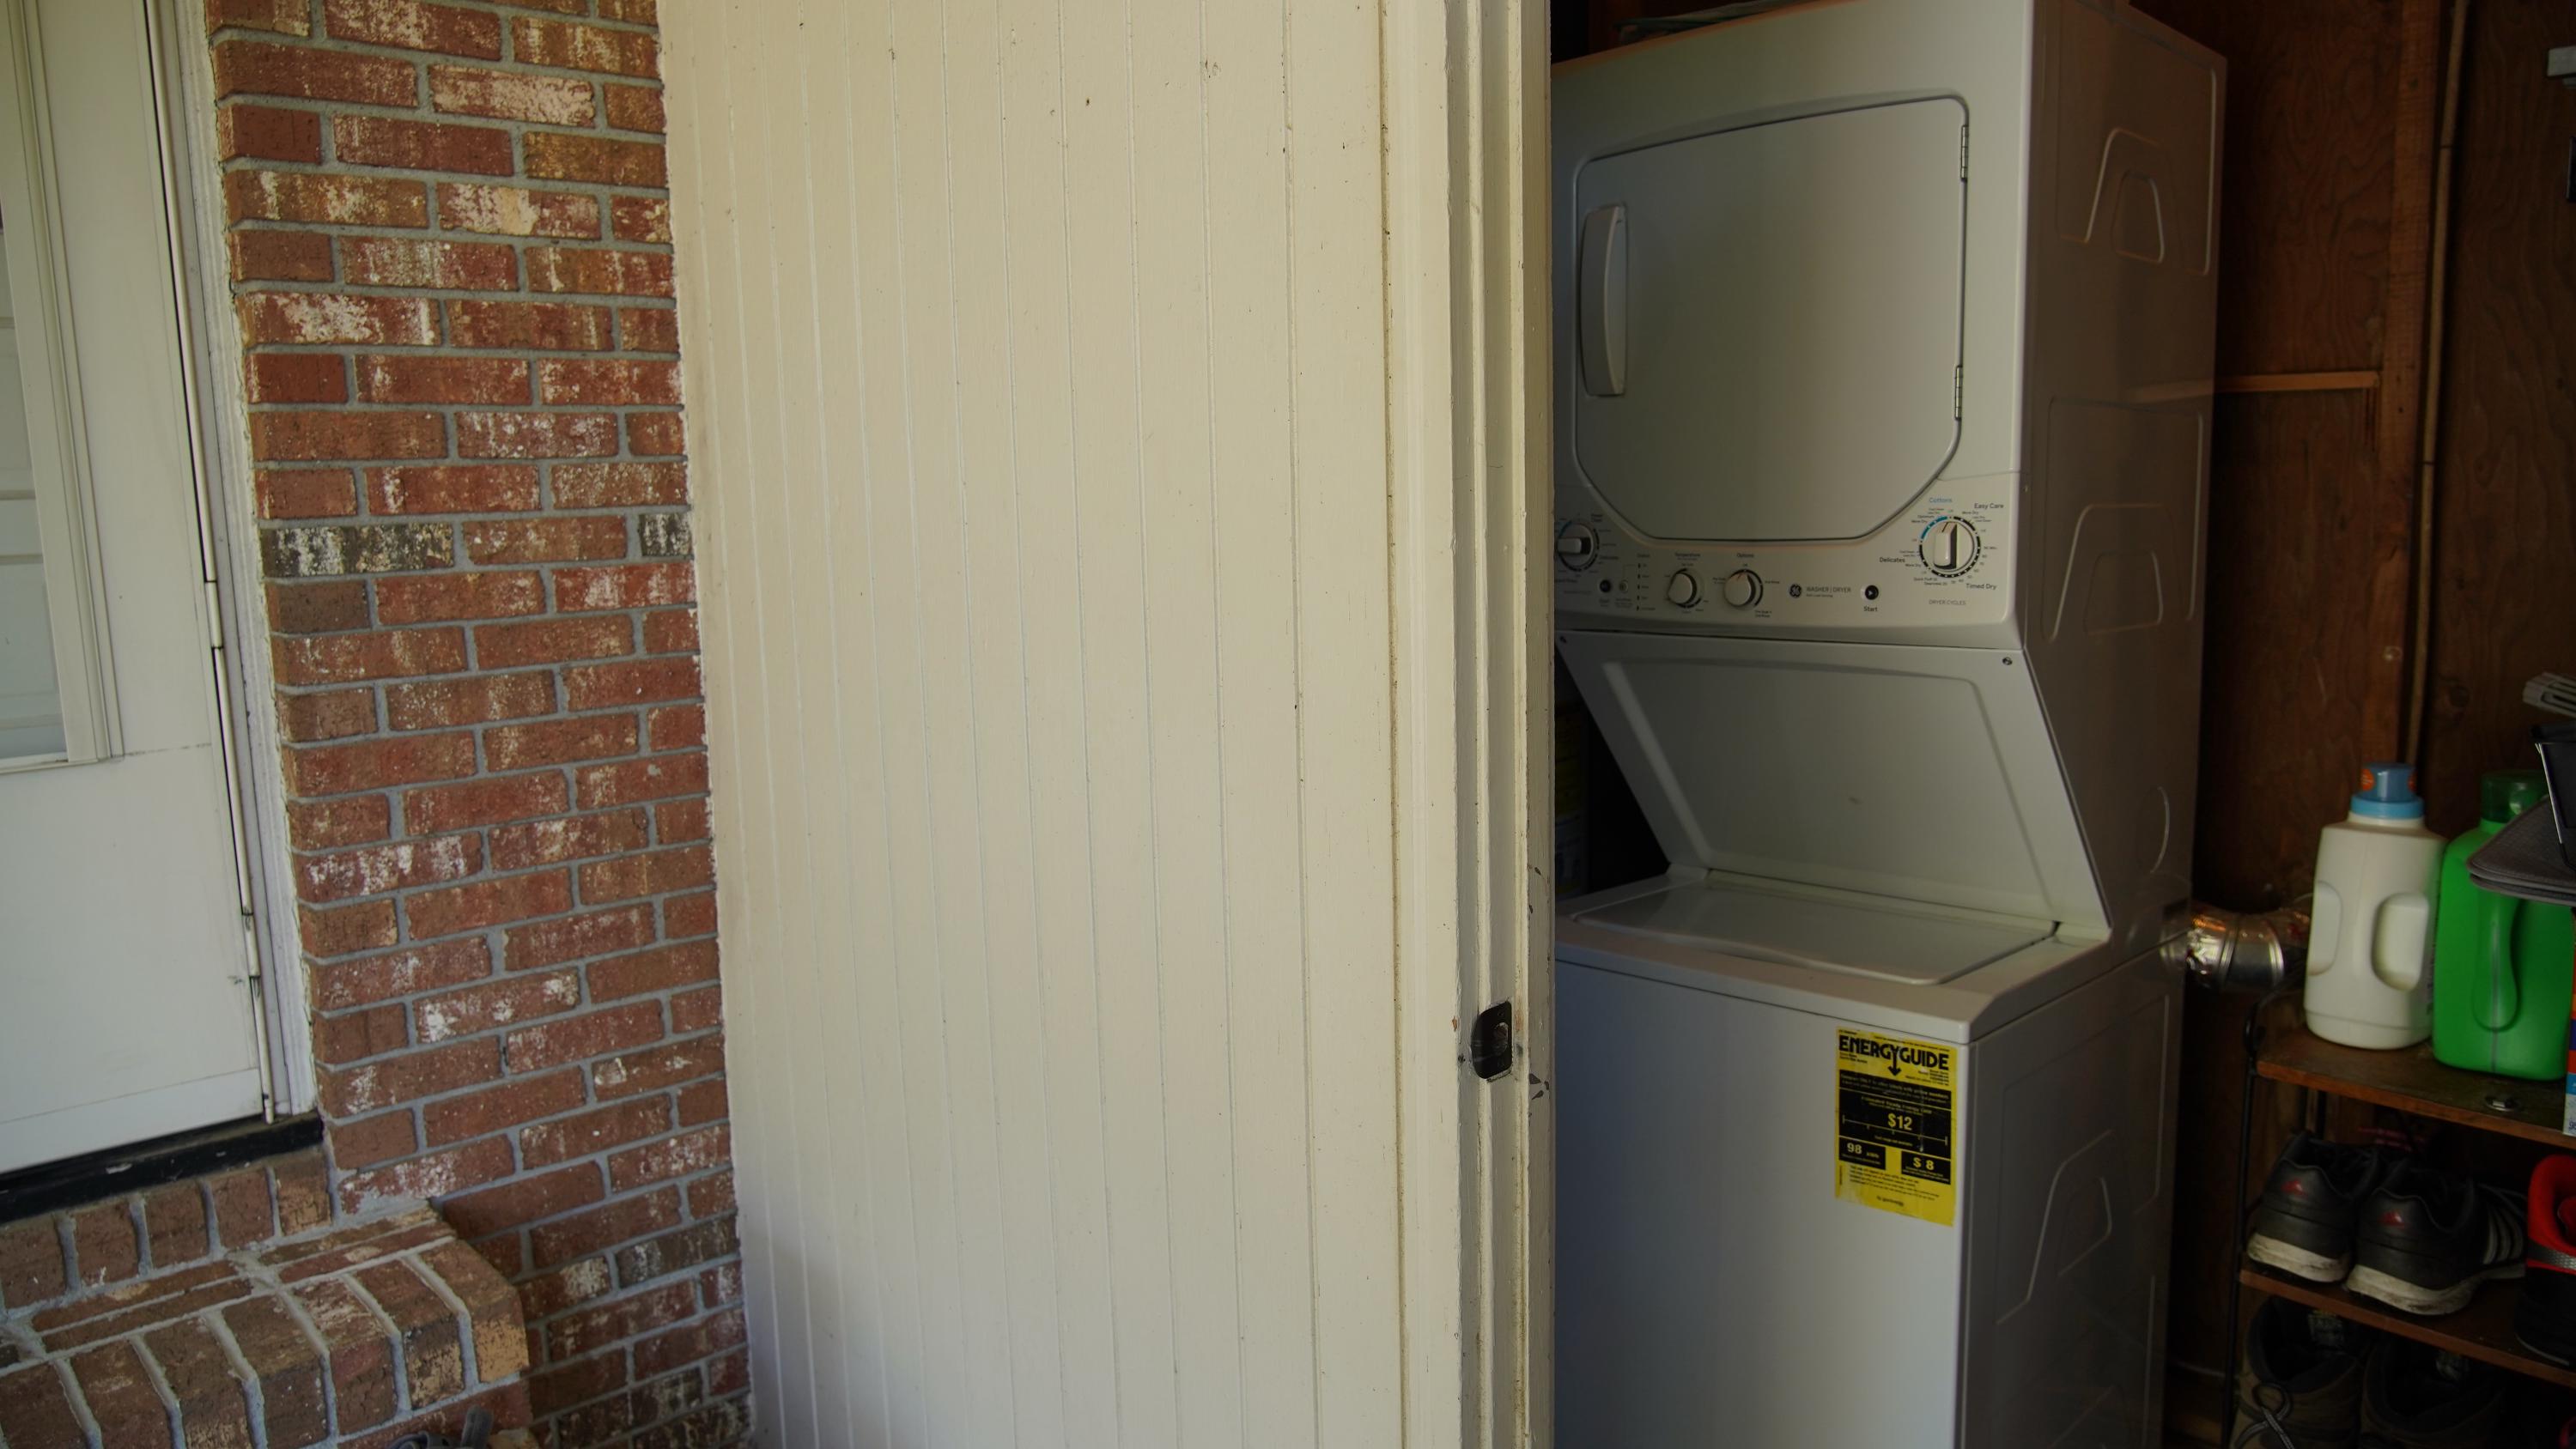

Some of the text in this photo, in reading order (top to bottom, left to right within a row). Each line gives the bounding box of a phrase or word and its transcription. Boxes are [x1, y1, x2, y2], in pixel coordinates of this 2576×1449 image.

[1838, 1034, 1950, 1070] ENERGYGUIDE
[1887, 1113, 1913, 1131] $12
[1846, 1142, 1862, 1155] 98
[1912, 1156, 1935, 1171] $ 8
